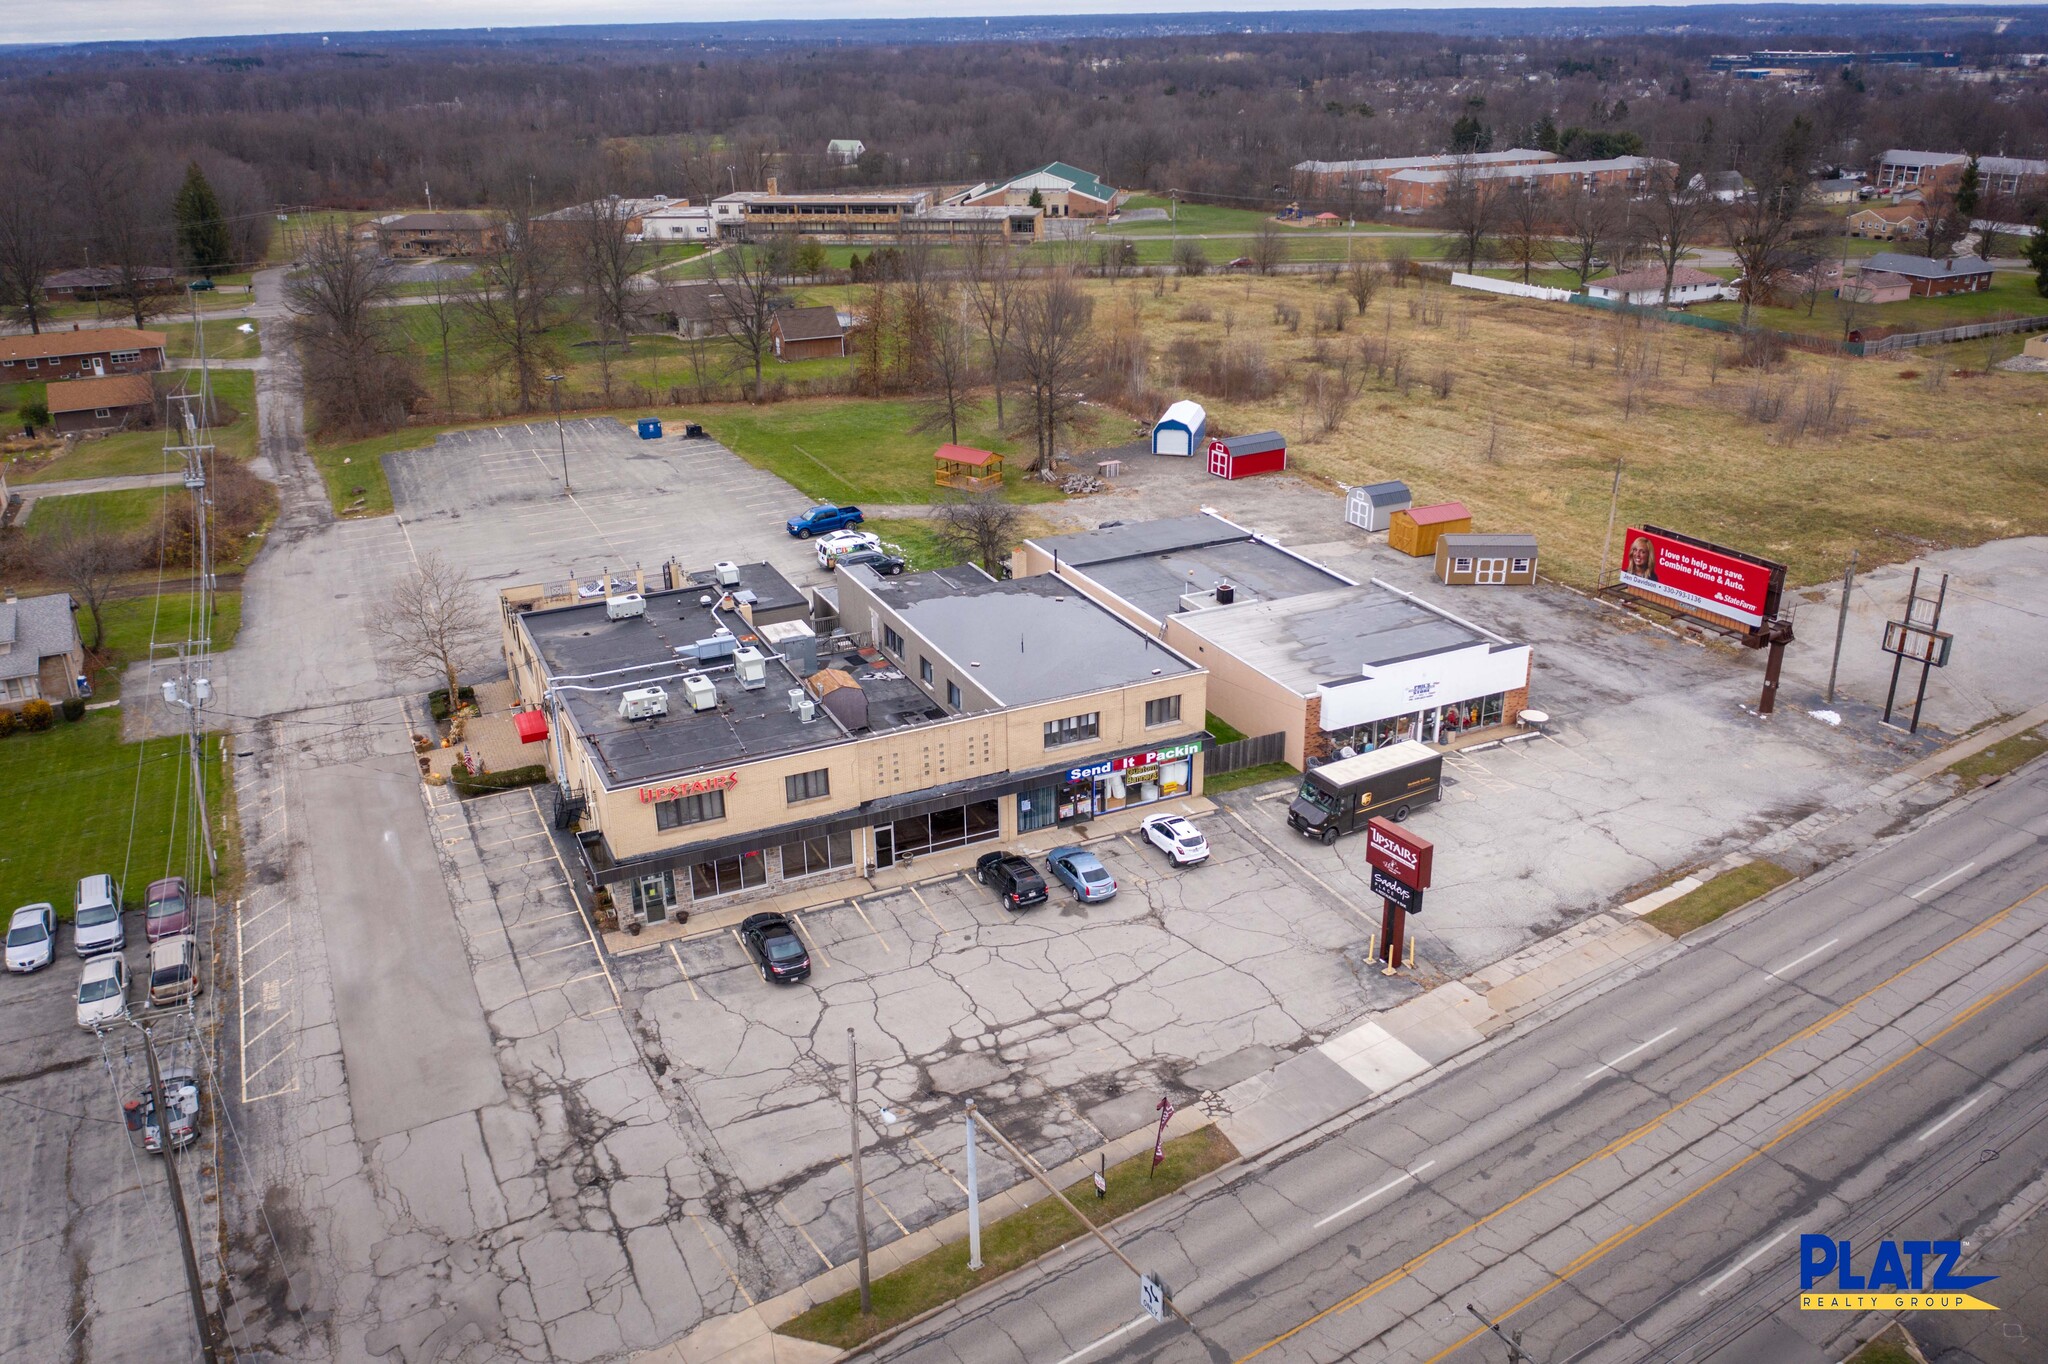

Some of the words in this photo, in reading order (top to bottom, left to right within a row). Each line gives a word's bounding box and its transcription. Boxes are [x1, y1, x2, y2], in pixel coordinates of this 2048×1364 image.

[1659, 558, 1692, 574] Combine
[1693, 568, 1715, 582] Home
[1717, 576, 1723, 585] &
[1724, 578, 1745, 592] Auto.
[1660, 548, 1664, 556] I
[1665, 549, 1681, 561] love
[1682, 554, 1690, 564] to
[1691, 558, 1708, 570] help
[1709, 564, 1722, 575] you
[1724, 567, 1744, 581] save.
[1623, 574, 1633, 582] Jen
[1634, 576, 1656, 589] Davidson
[1663, 586, 1702, 604] 330-793-1136
[1071, 762, 1111, 780] Send
[1123, 758, 1135, 768] It
[1146, 743, 1198, 764] Packin
[639, 771, 738, 804] UPSTAIRS
[1370, 827, 1417, 864] UPSTAIRS
[1374, 882, 1394, 896] PLACE
[1143, 1299, 1158, 1316] ONLY
